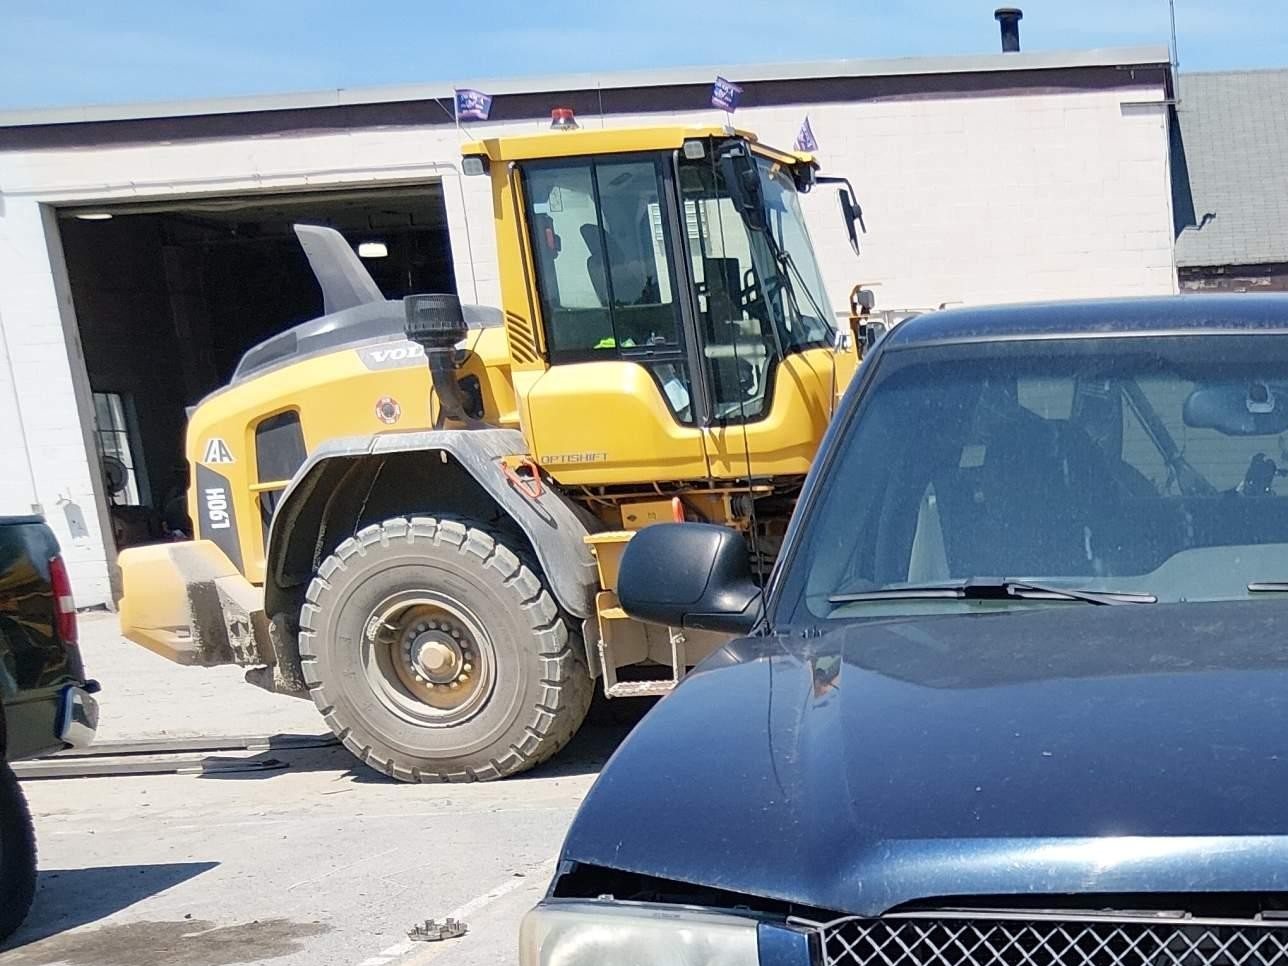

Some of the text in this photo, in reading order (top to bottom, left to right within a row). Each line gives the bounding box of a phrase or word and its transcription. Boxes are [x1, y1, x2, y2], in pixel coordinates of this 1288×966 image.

[369, 346, 424, 363] VOL
[541, 452, 609, 464] OPTISHIFT
[205, 488, 231, 529] L90H
